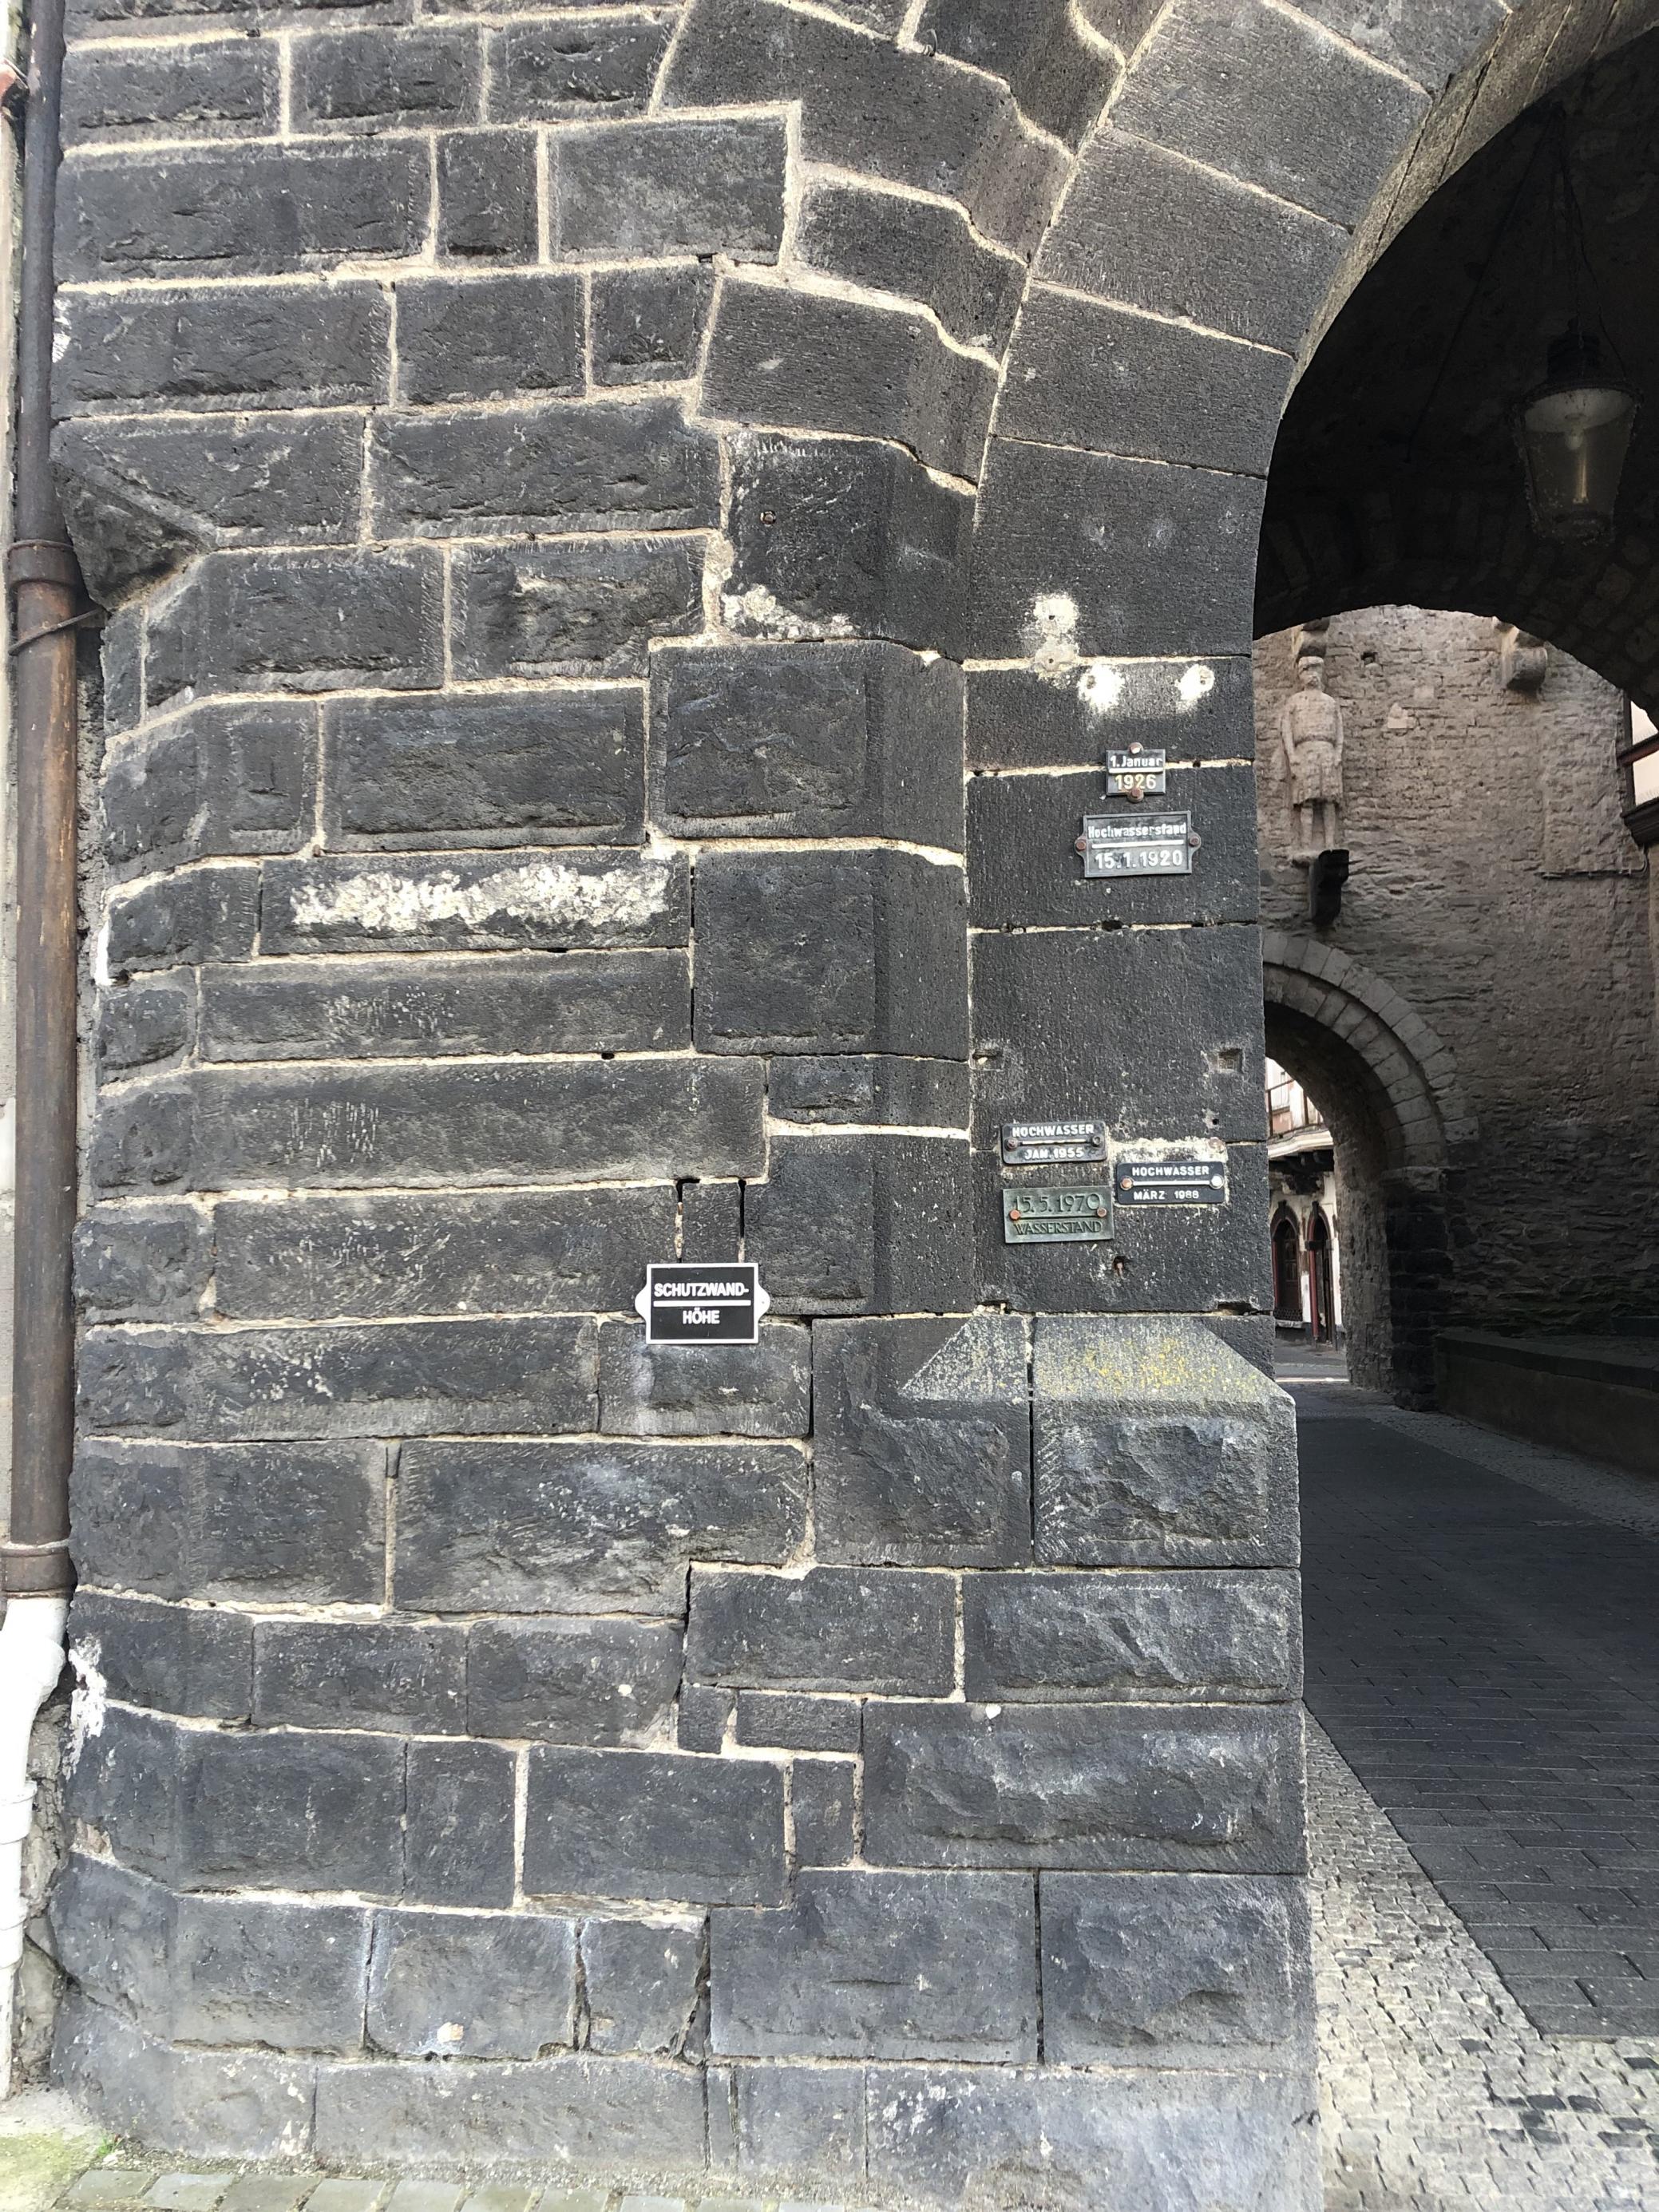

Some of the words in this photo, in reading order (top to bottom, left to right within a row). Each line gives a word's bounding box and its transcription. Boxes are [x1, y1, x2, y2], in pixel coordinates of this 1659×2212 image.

[1115, 774, 1157, 790] 1926
[1087, 822, 1187, 838] Hochwasserstand
[1012, 1124, 1095, 1138] HOCHWASSER
[1131, 1165, 1210, 1177] HOCHWASSER
[1133, 1189, 1166, 1200] MÄRZ
[1174, 1189, 1199, 1199] 1988
[1013, 1220, 1103, 1235] WASSERSTAND
[654, 1282, 750, 1297] SCHUTZWAND-
[682, 1307, 720, 1324] HÖHE
